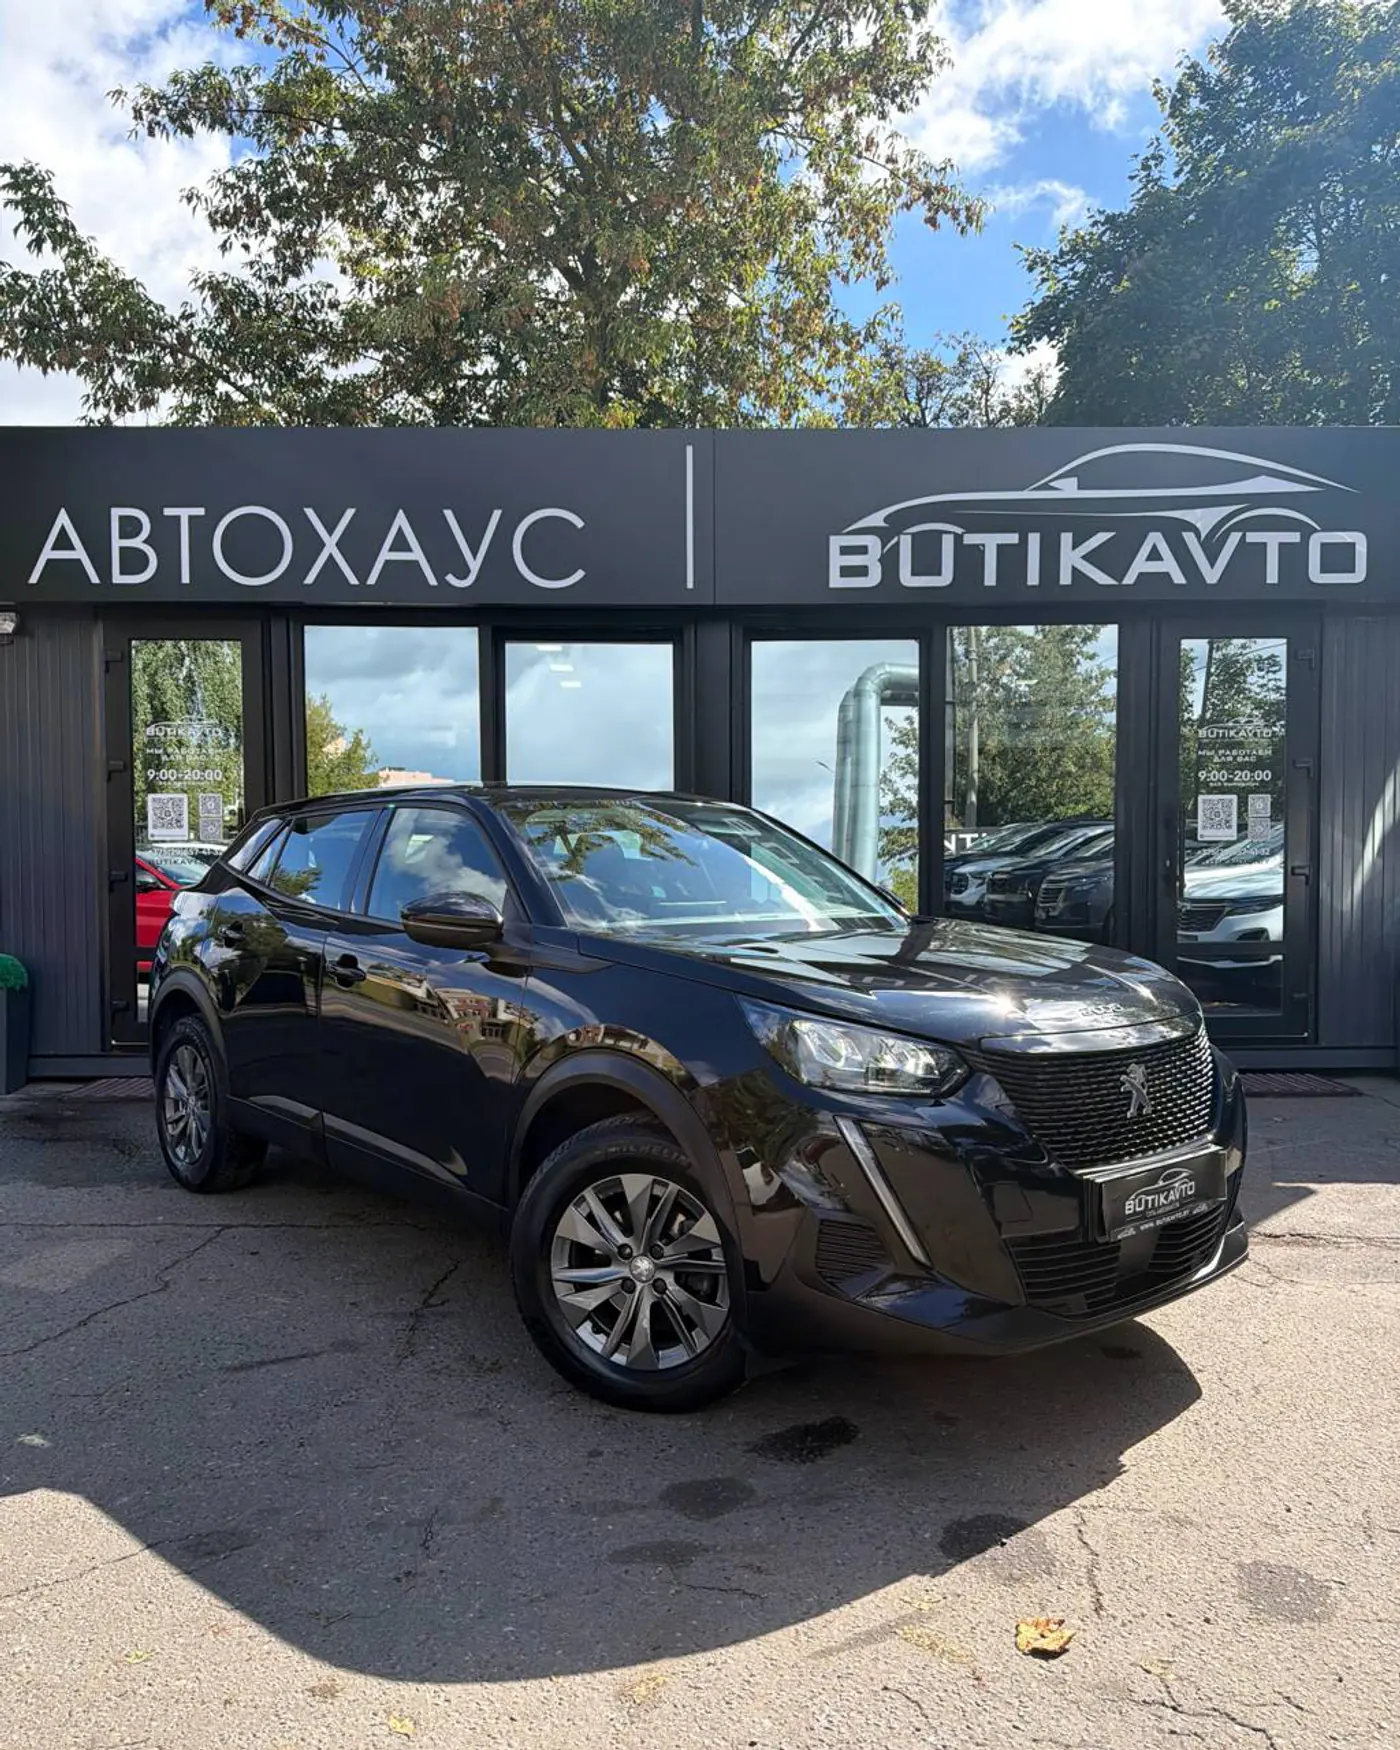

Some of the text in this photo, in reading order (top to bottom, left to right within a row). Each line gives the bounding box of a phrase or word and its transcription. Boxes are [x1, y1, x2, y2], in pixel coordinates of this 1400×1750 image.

[28, 505, 587, 589] АВТОХАУС
[828, 531, 1367, 588] BUTIKAVTO
[1198, 728, 1272, 738] BUTIKAVTO
[147, 769, 223, 780] 9:00-20:00
[1198, 770, 1272, 781] 9:00-20:00
[1125, 1181, 1195, 1215] BUTIKAVTO
